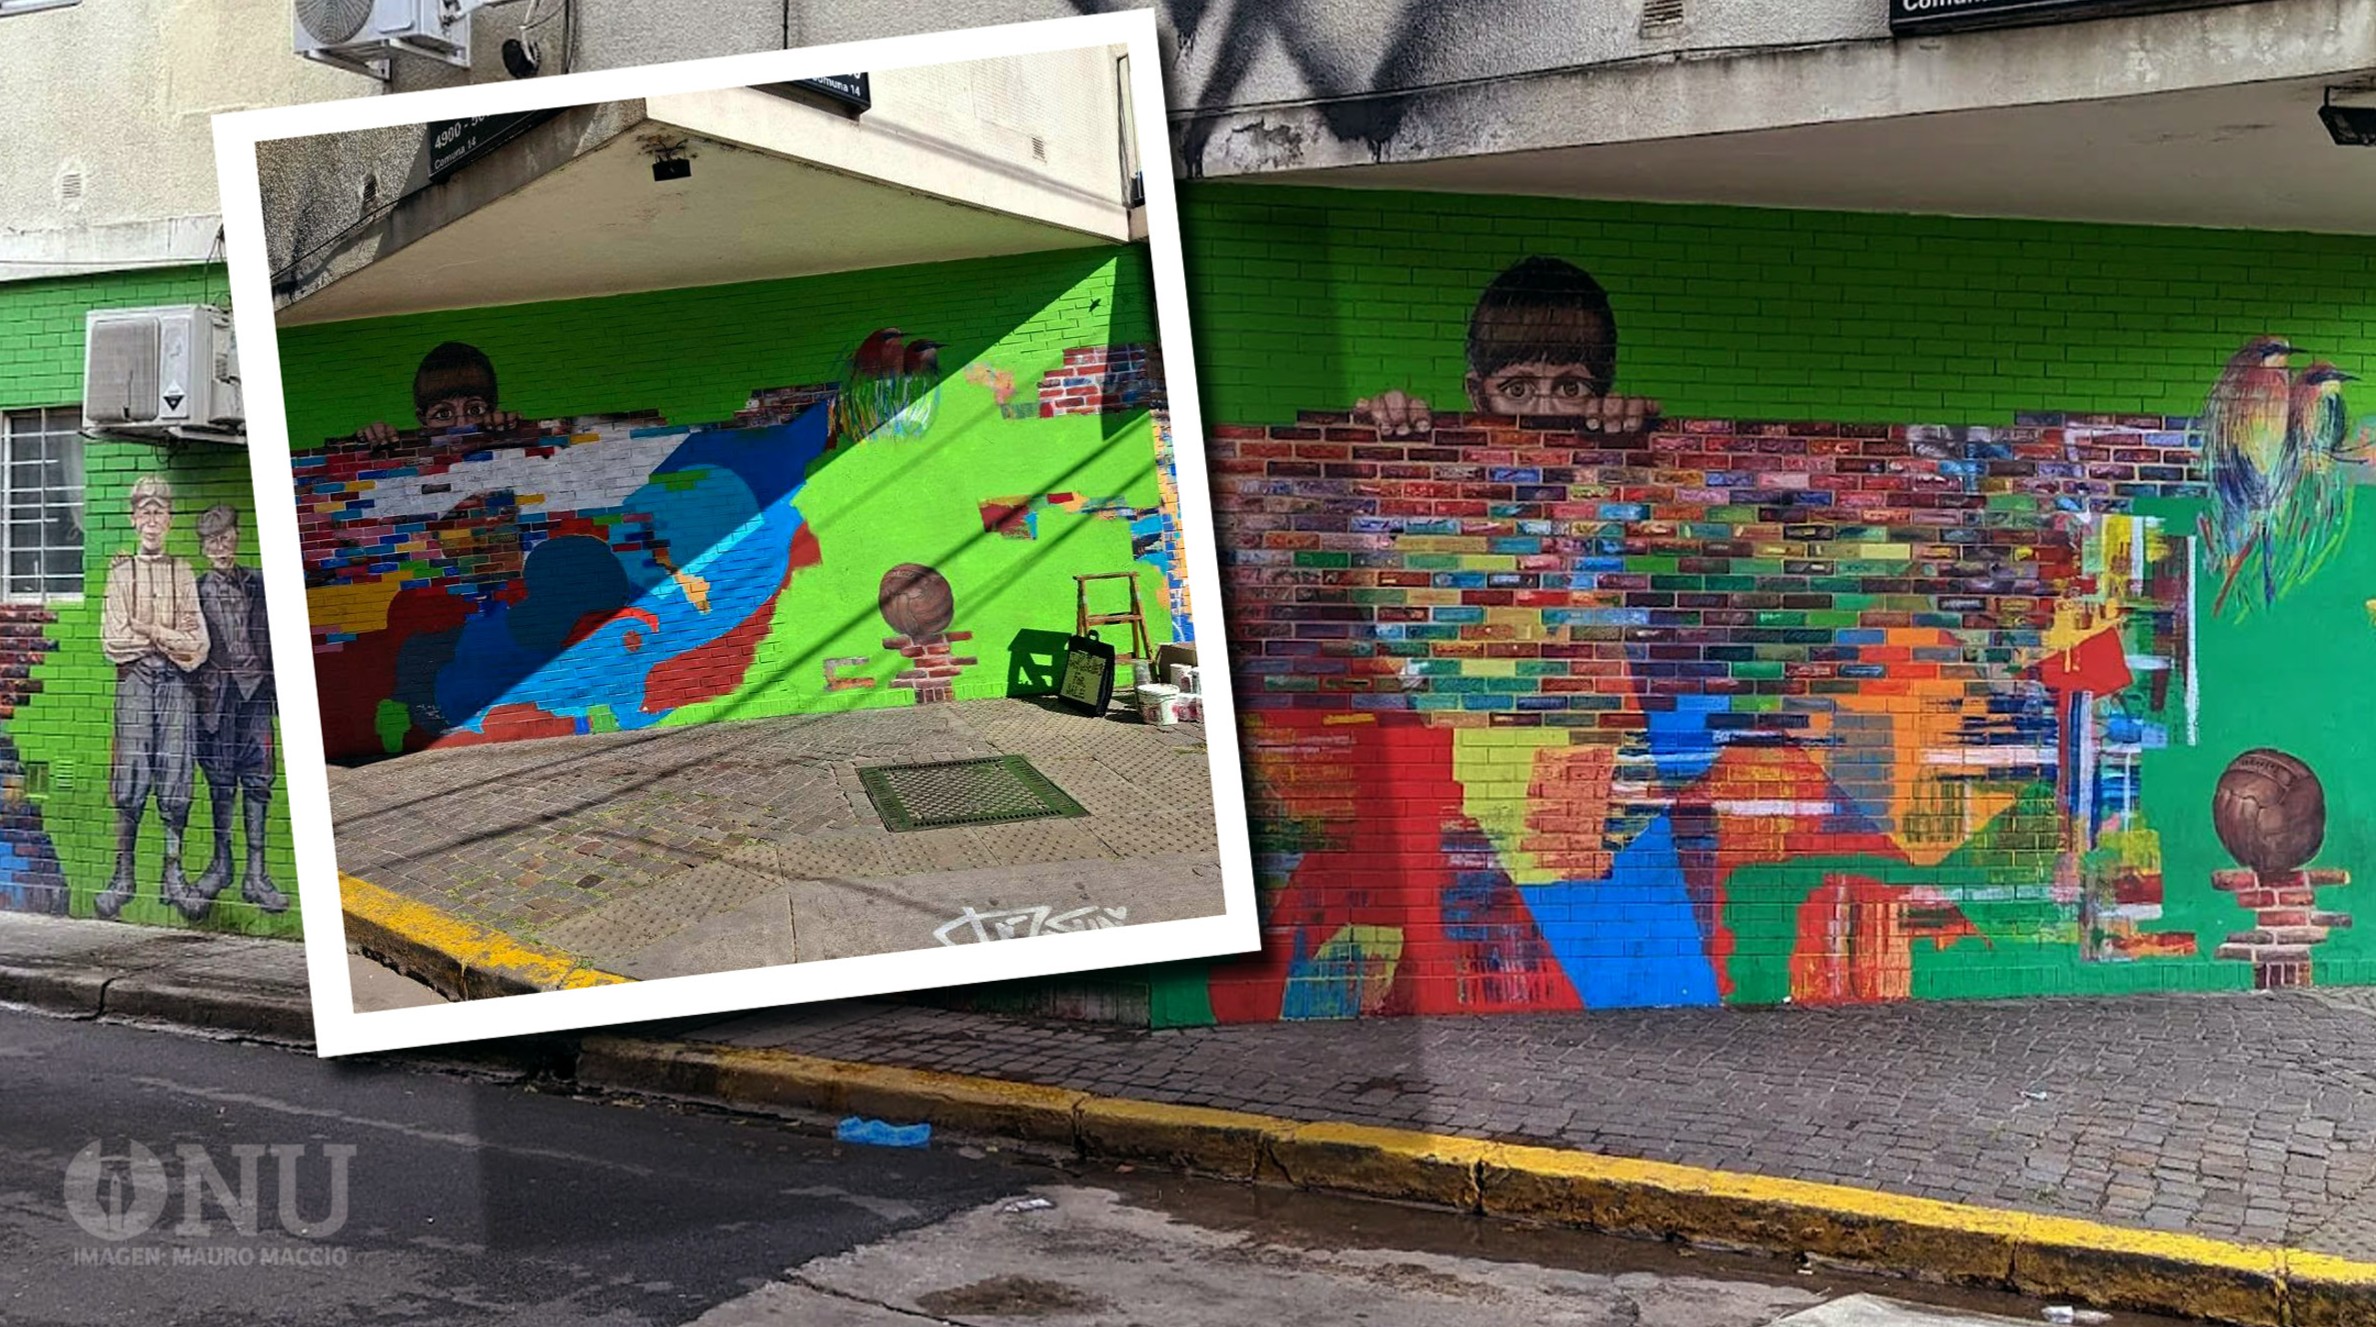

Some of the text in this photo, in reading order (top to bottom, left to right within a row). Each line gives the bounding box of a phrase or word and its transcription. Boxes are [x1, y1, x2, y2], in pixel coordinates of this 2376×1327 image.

[1902, 0, 1990, 12] Com
[850, 84, 861, 97] 14
[434, 121, 462, 149] 4900
[434, 145, 466, 169] Comuna
